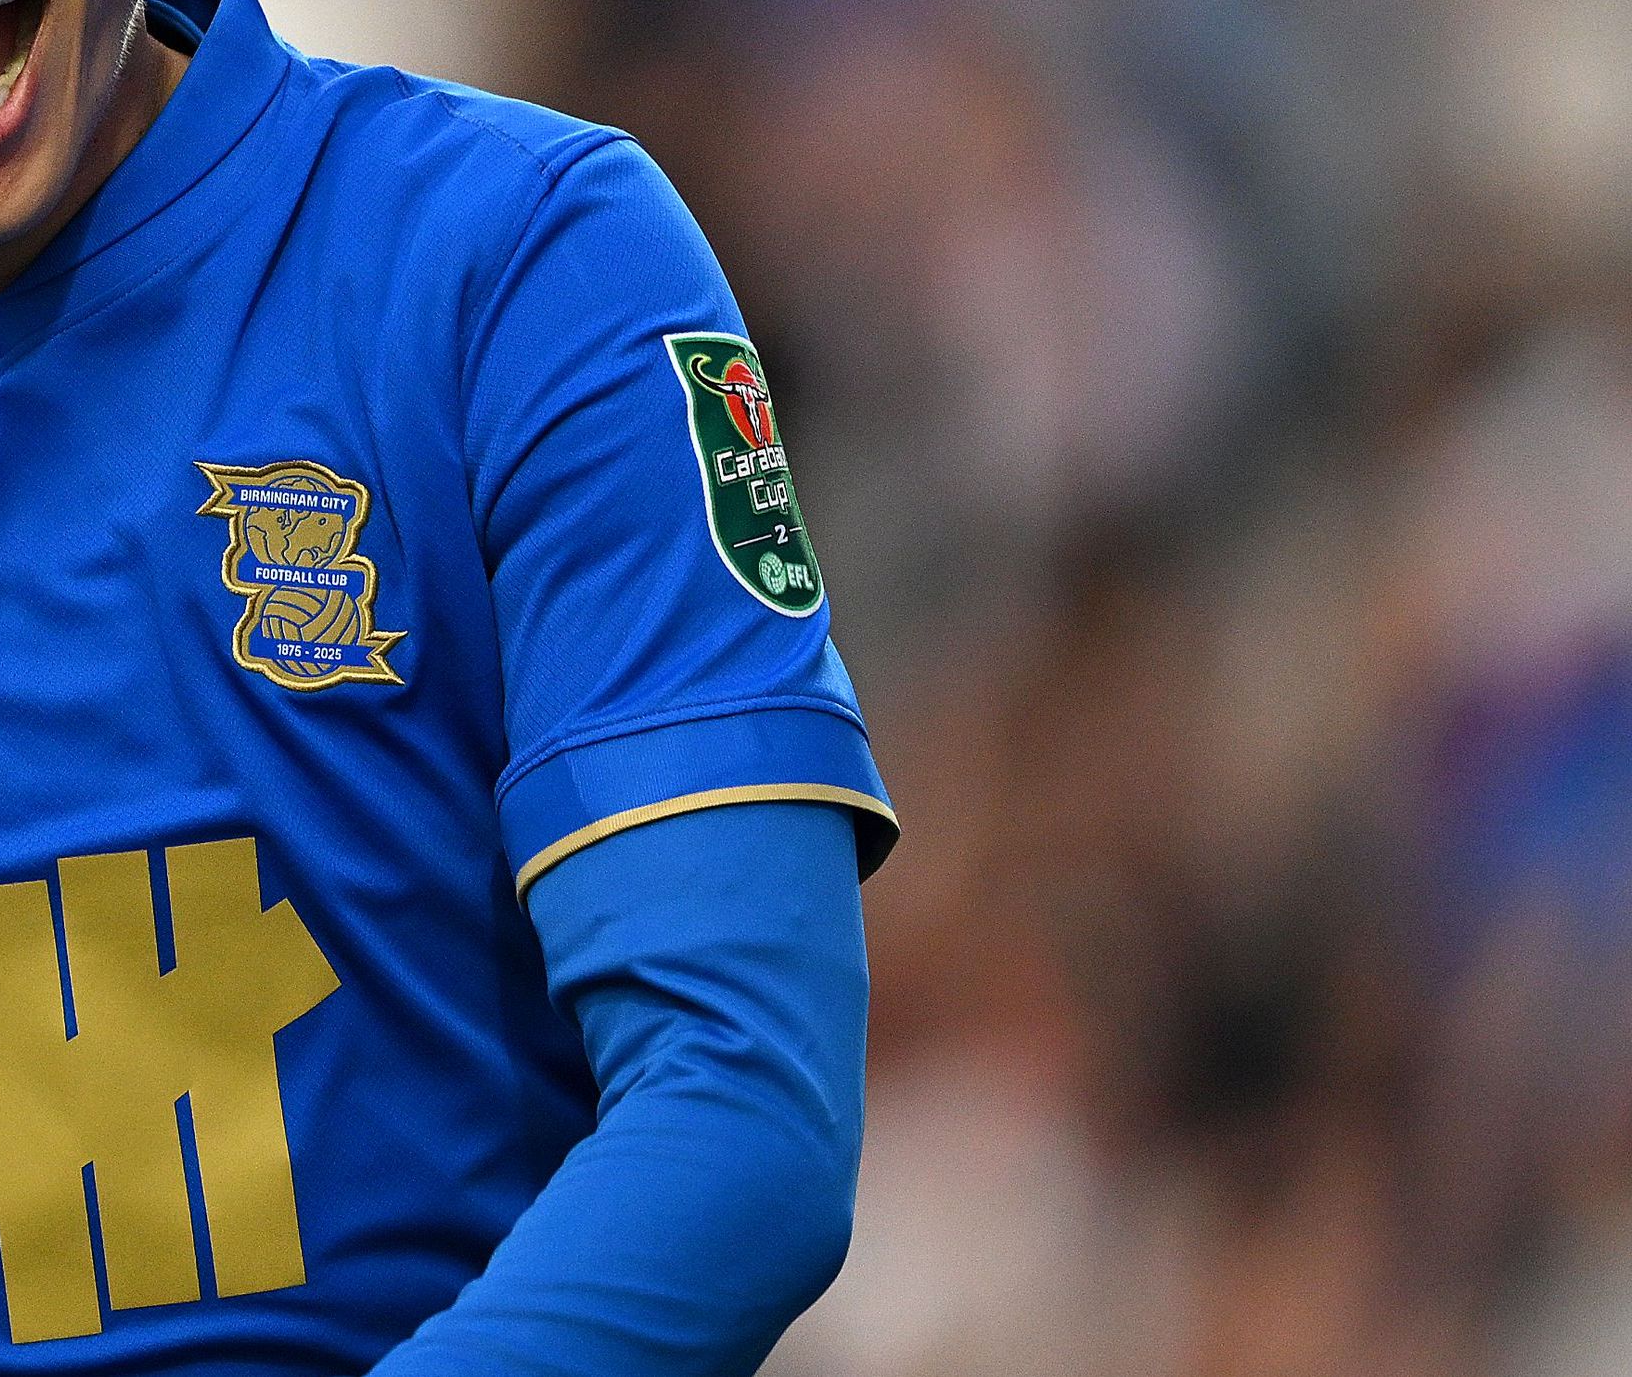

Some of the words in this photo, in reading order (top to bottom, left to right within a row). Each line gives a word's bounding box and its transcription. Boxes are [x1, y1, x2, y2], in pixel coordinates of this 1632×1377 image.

[240, 488, 318, 508] BIRMINGHAM
[321, 497, 349, 511] CITY
[750, 479, 789, 511] Cup
[774, 525, 788, 544] 2
[255, 567, 315, 584] FOOTBALL
[317, 573, 348, 586] CLUB
[786, 563, 815, 591] EFL
[277, 643, 302, 657] 1875
[313, 646, 342, 660] 2025
